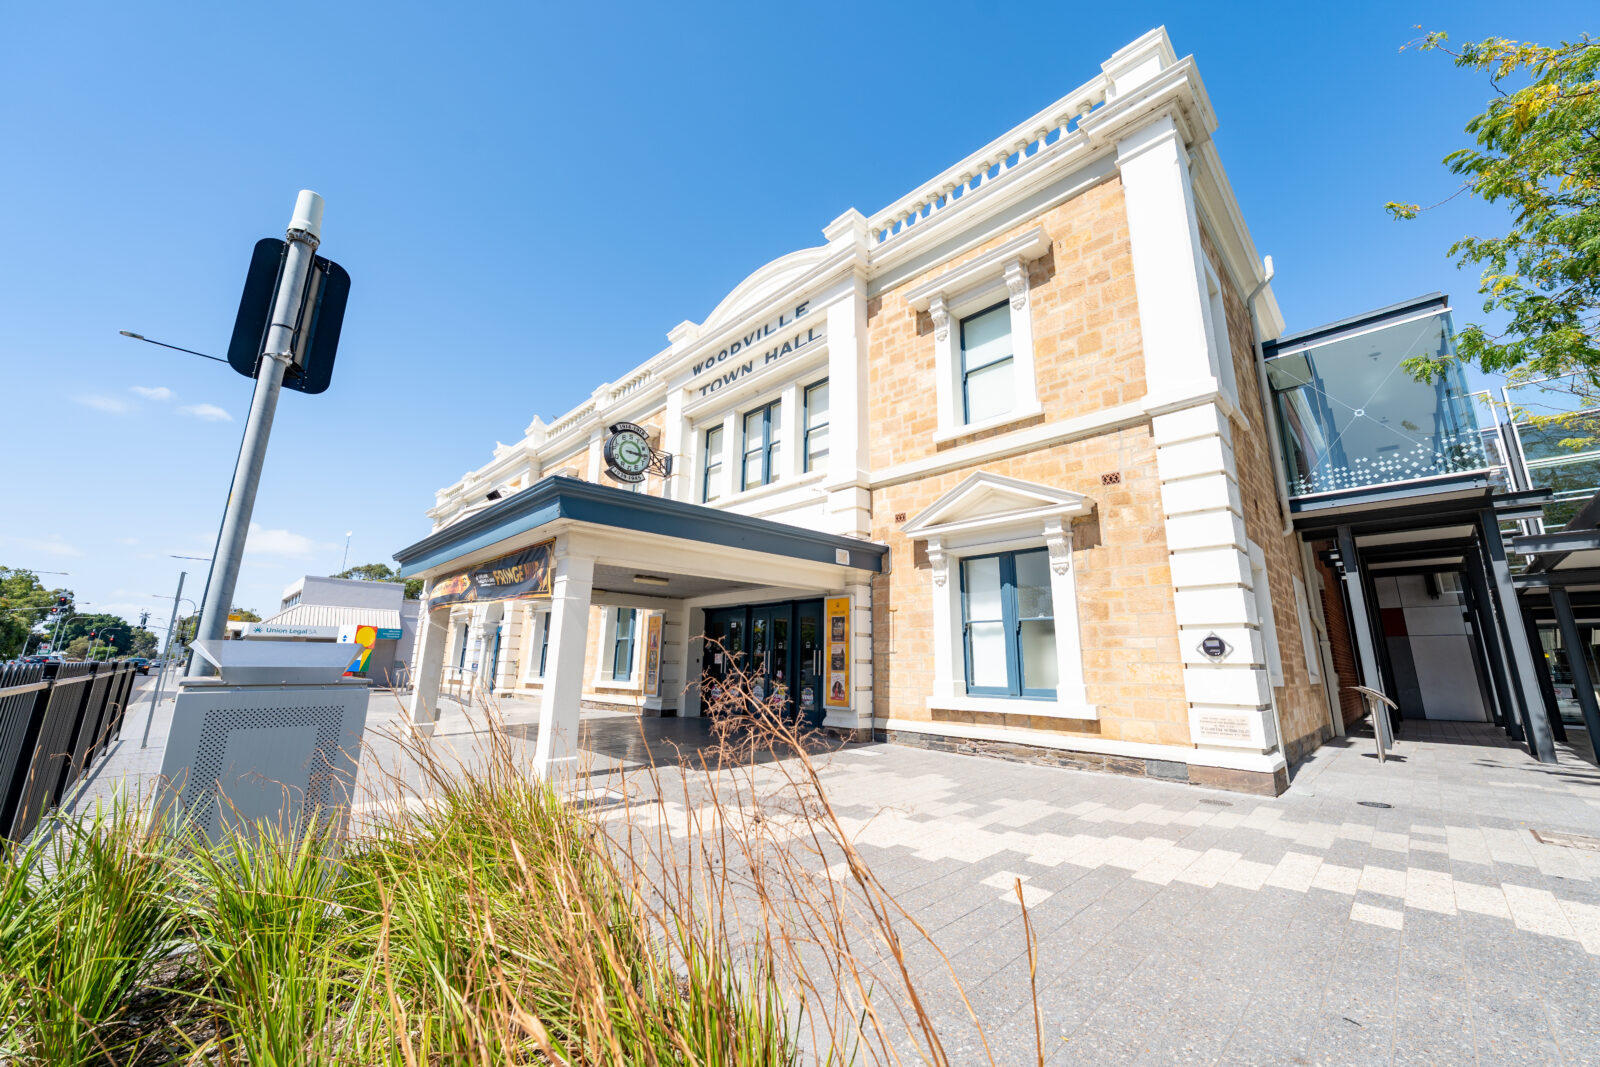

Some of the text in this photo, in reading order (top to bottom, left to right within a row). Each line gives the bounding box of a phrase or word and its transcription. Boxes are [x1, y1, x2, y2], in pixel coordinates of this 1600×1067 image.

[692, 300, 810, 376] WOODVILLE
[698, 327, 822, 397] TOWN HALL
[615, 434, 640, 445] LEST
[612, 446, 645, 472] FORGET
[492, 565, 523, 585] FRINGE
